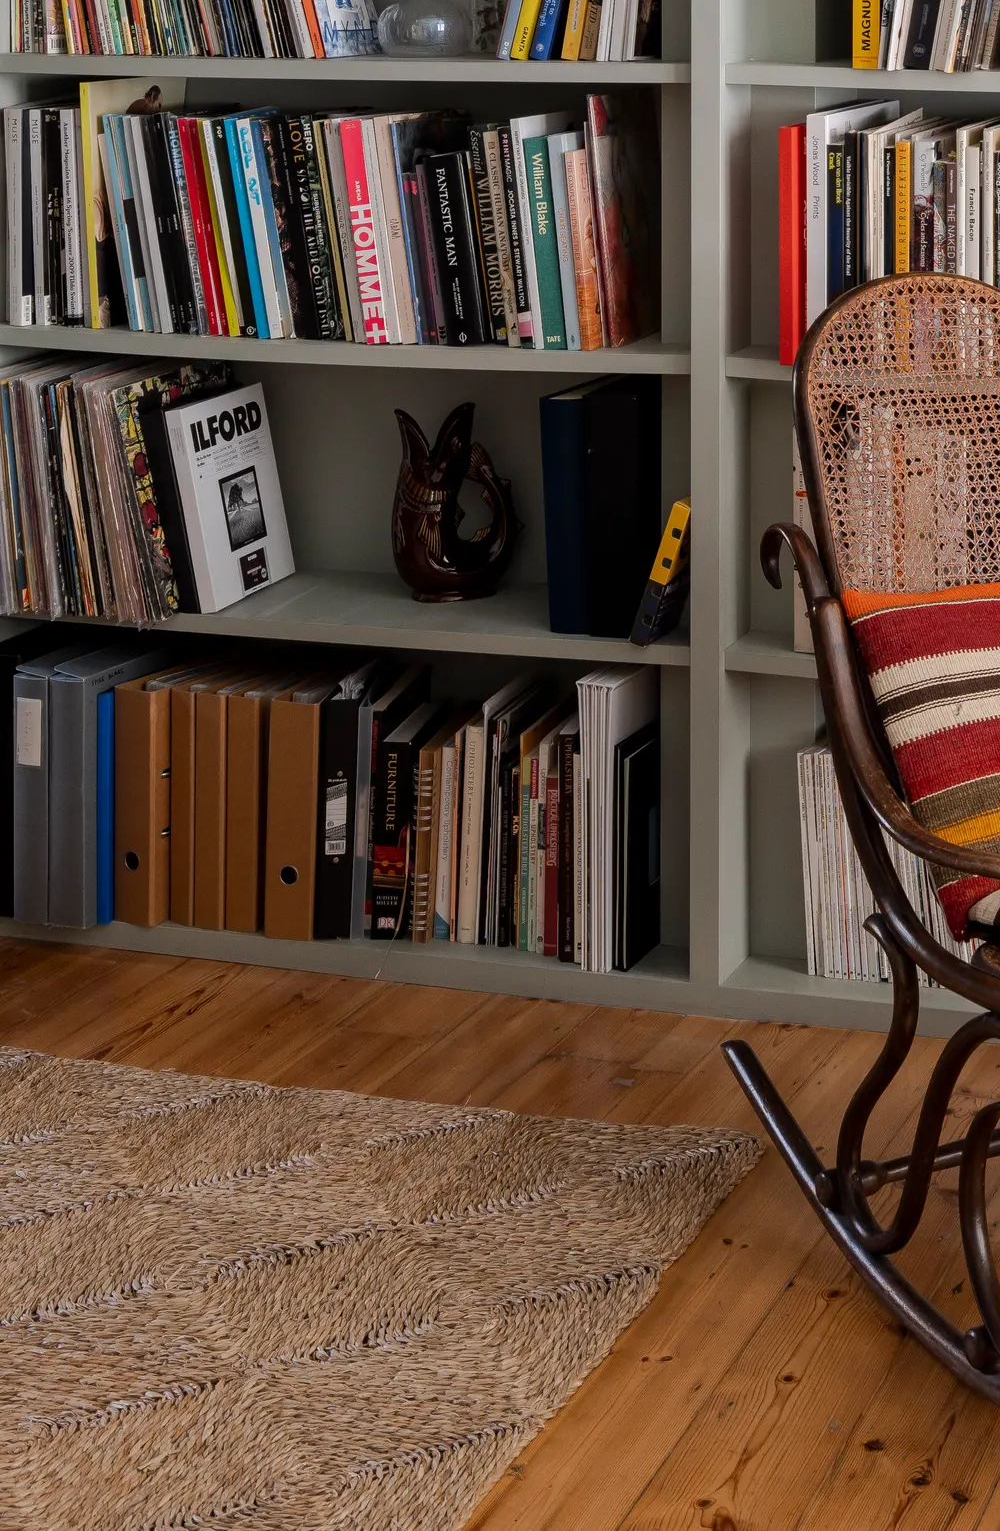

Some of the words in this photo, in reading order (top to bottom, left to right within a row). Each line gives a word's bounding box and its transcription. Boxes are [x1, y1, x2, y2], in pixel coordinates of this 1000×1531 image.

[518, 26, 528, 52] GRANTA
[288, 123, 305, 164] LOVE
[303, 123, 314, 151] HERO
[812, 136, 820, 160] Jonas
[531, 153, 543, 199] William
[812, 162, 820, 186] Wood
[354, 180, 362, 201] ARENA
[506, 189, 517, 220] JOCASTA
[435, 168, 453, 233] FANTASTIC
[444, 237, 458, 267] MAN
[510, 220, 518, 239] INNES
[536, 203, 548, 235] Blake
[475, 177, 495, 247] WILLIAM
[485, 253, 504, 316] MORRIS
[513, 245, 523, 277] STEWART
[350, 203, 387, 344] HOMME+
[517, 278, 525, 307] WALTON
[546, 335, 561, 343] TATE
[190, 401, 262, 453] ILFORD
[467, 740, 476, 798] UPHOLSTERY
[385, 753, 398, 831] FURNITURE
[442, 760, 454, 818] Contemporary
[441, 819, 451, 862] Upholstery
[379, 917, 394, 928] DK
